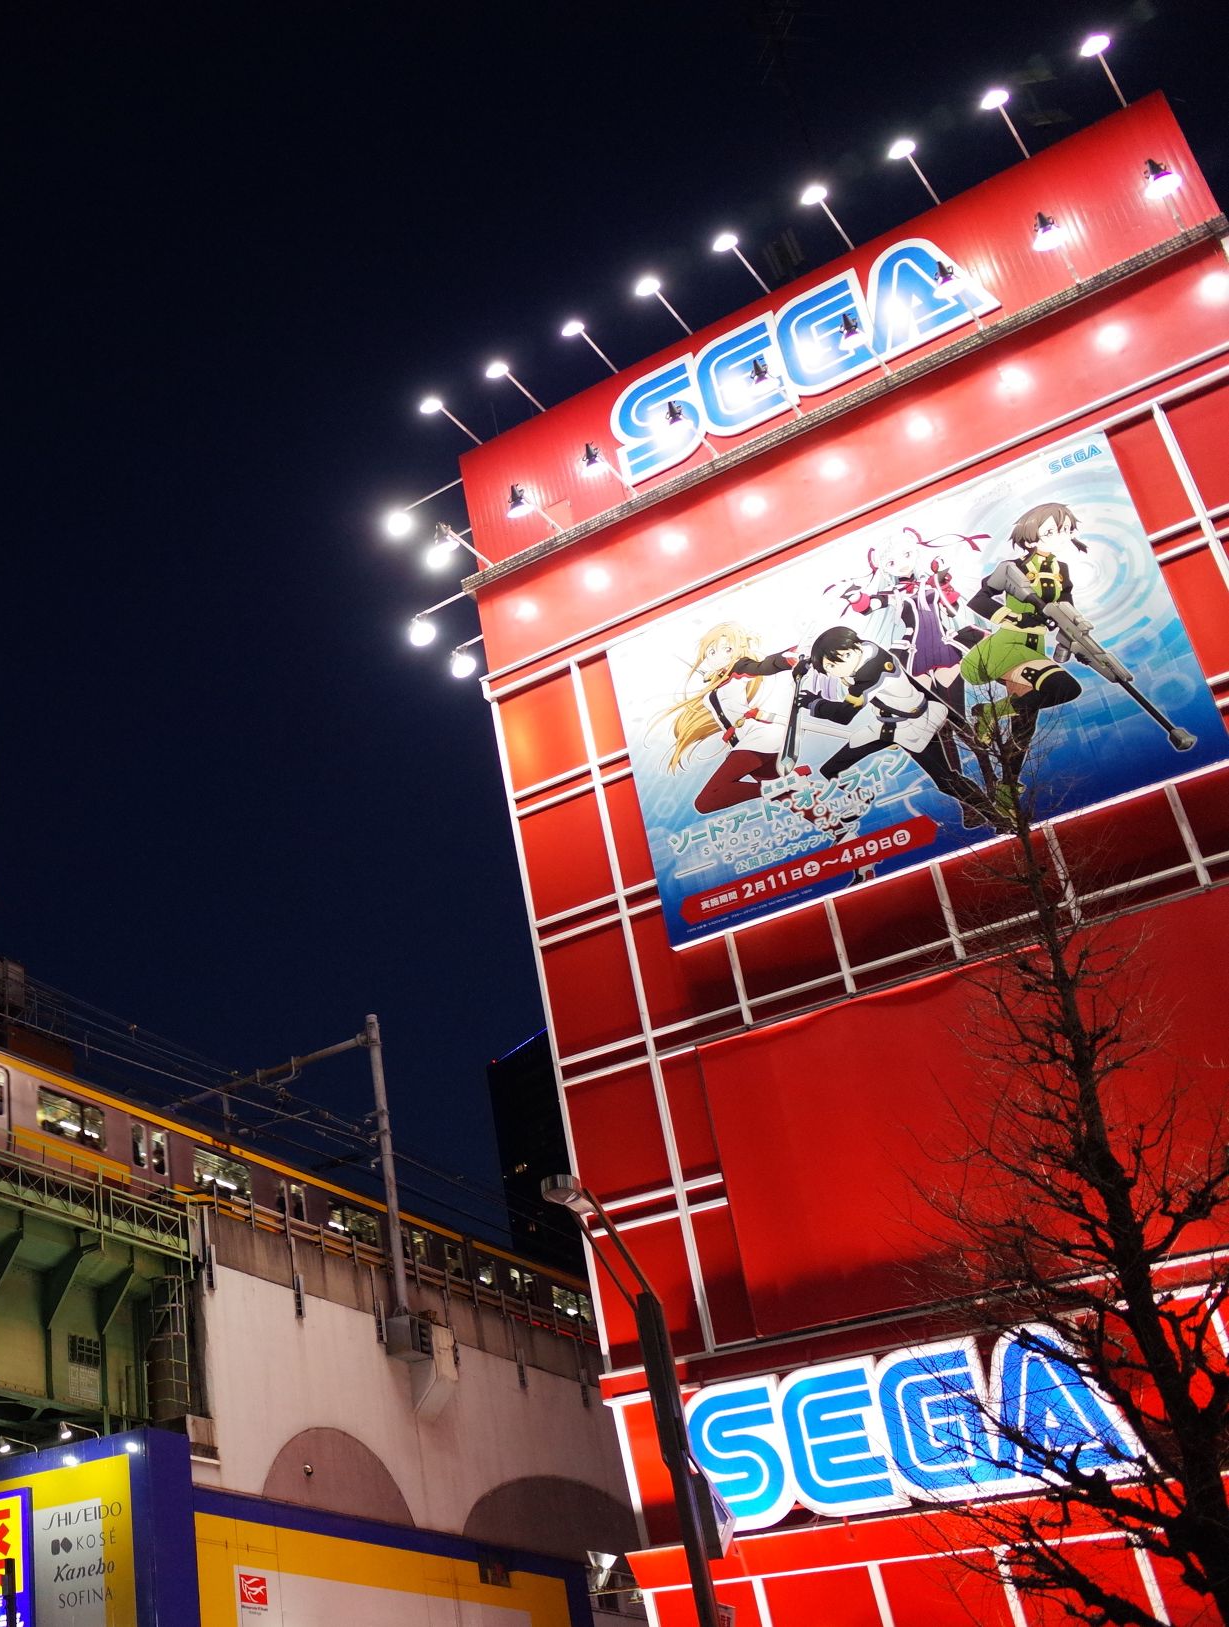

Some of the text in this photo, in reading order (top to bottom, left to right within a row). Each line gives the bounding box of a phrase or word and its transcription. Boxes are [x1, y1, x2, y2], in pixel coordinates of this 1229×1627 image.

[610, 239, 1000, 485] SEGA
[1048, 444, 1102, 475] SEGA
[703, 784, 884, 857] SWORD ART ONLINE
[684, 1324, 1158, 1530] SEGA
[42, 1501, 122, 1531] SHISEIDO
[76, 1526, 117, 1551] KOSÉ
[53, 1556, 115, 1583] Kanebo
[58, 1586, 113, 1609] SOFINA
